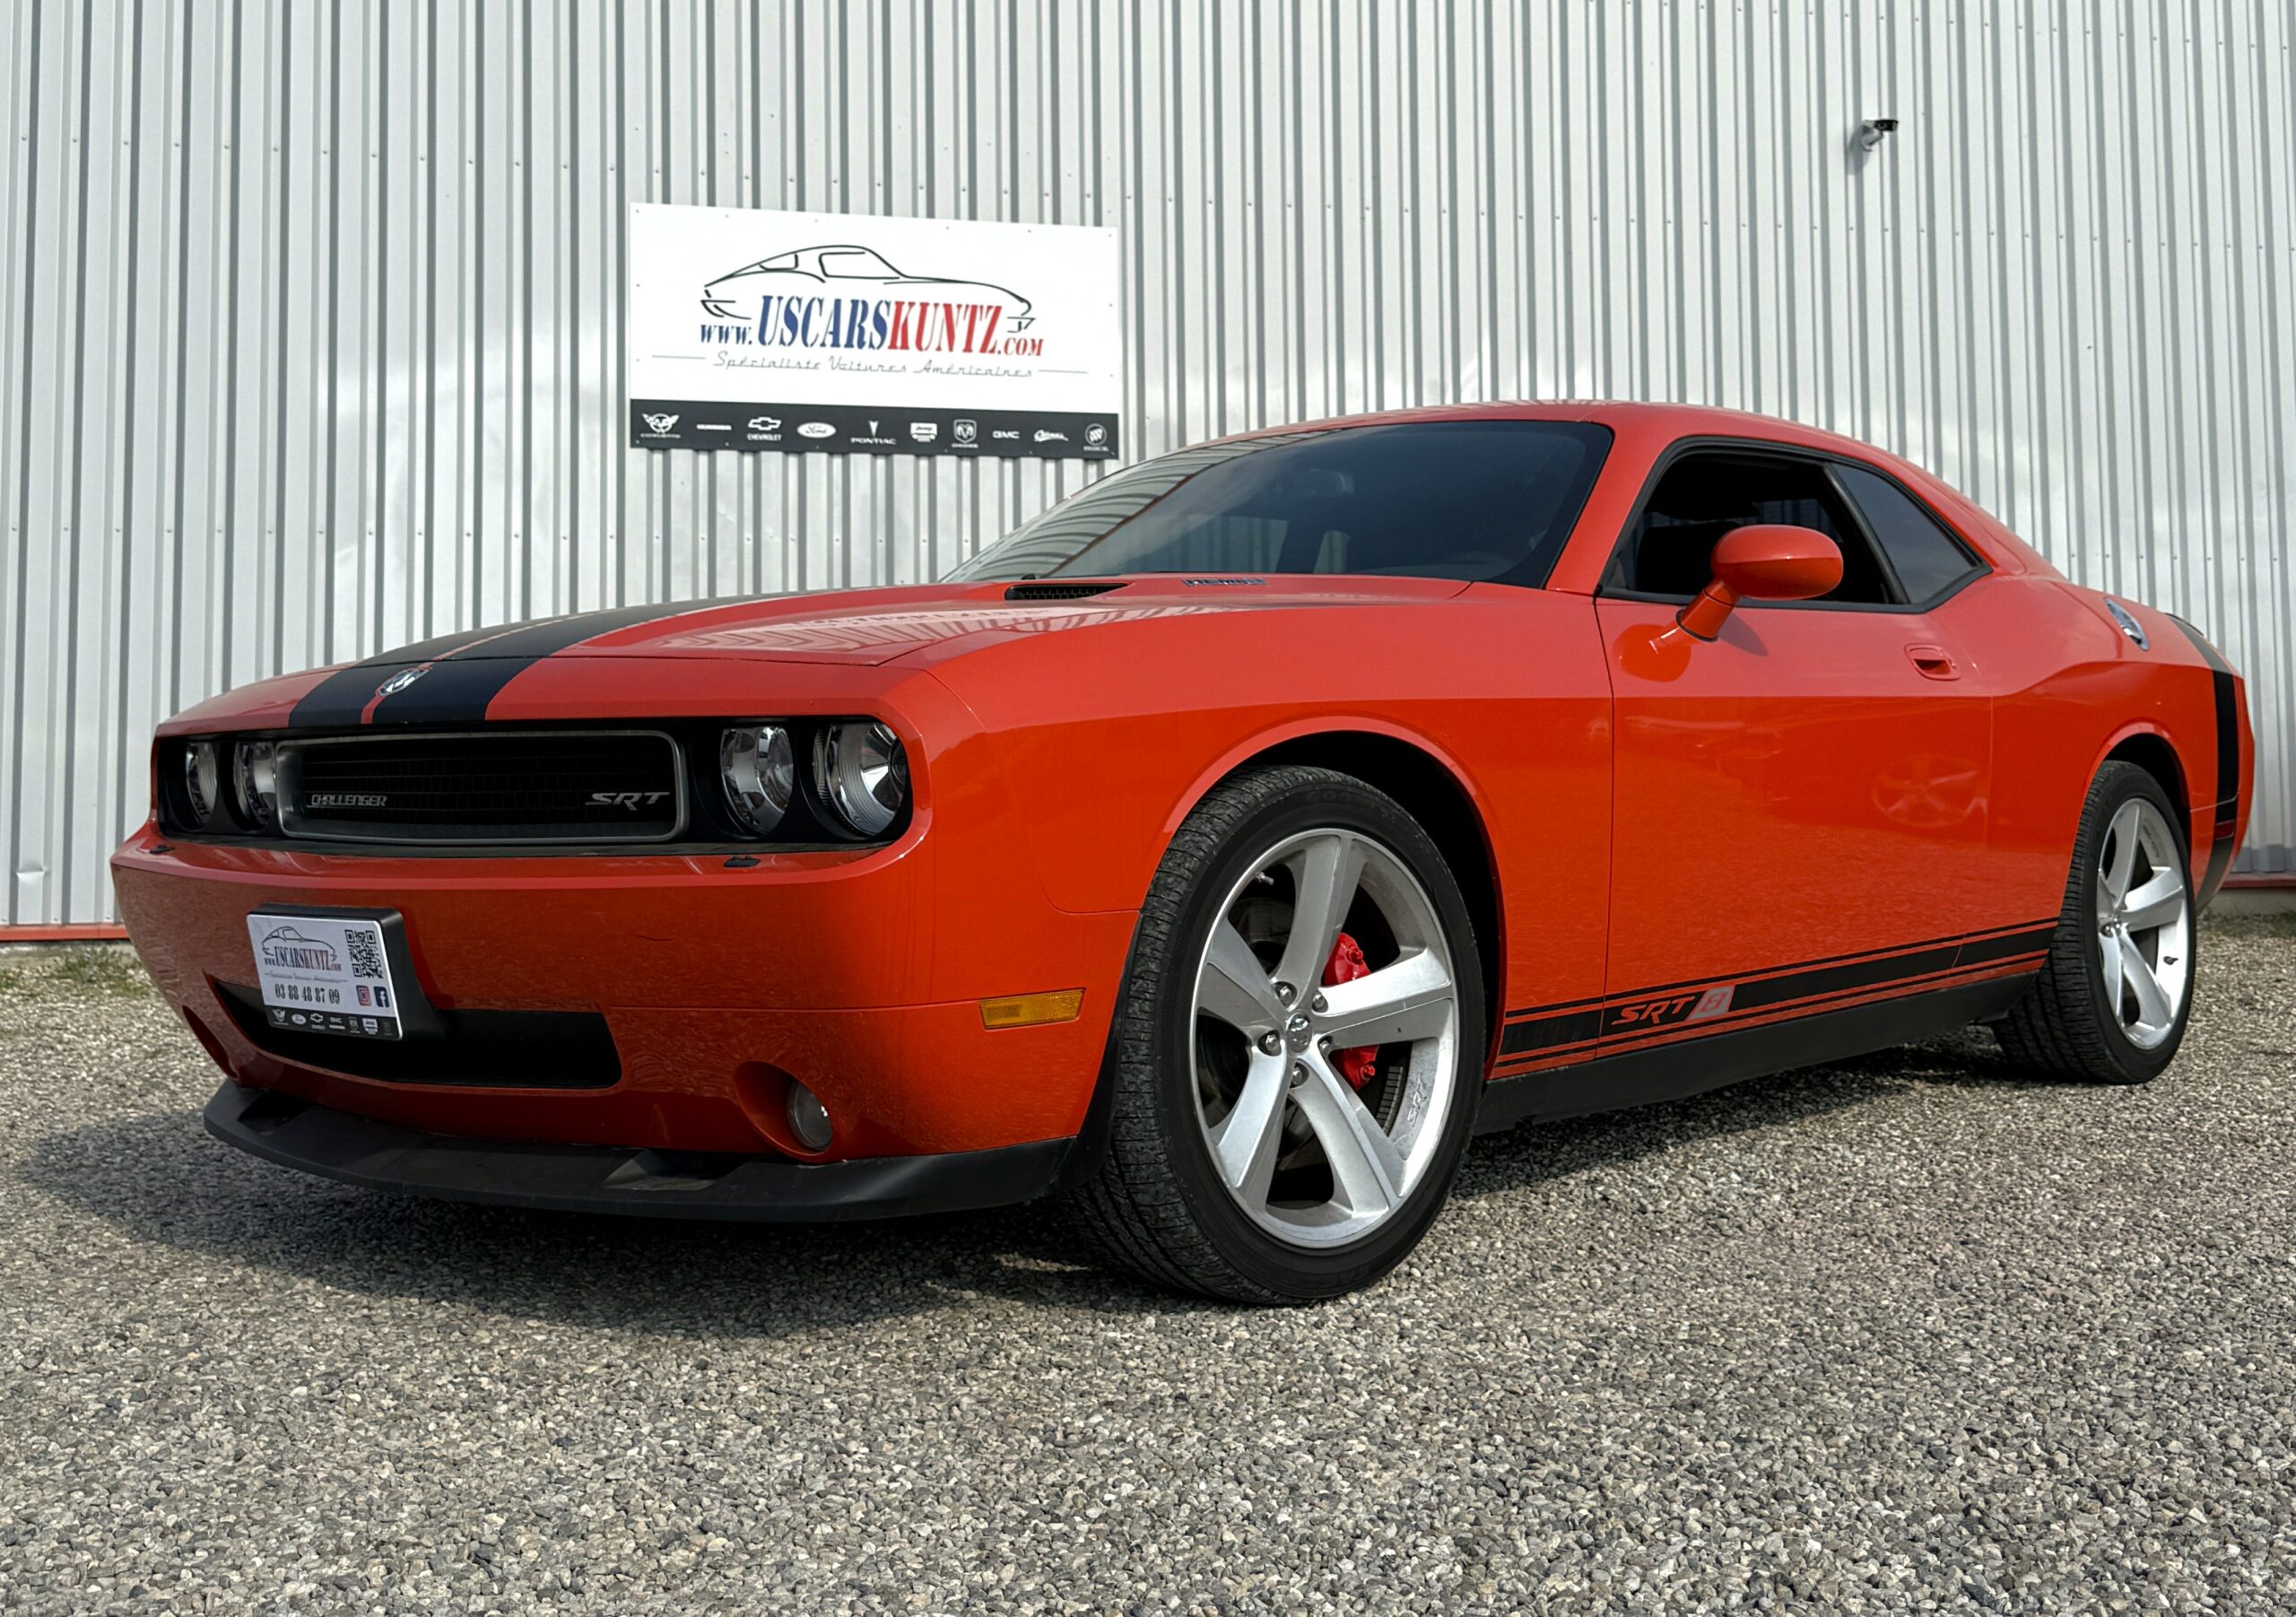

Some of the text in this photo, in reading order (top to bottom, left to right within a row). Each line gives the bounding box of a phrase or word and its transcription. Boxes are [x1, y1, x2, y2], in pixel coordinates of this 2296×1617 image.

[713, 351, 1032, 378] Spécialiste Voitures Américaines
[747, 433, 782, 442] CHEVROLET
[850, 437, 897, 445] PONTIAC
[992, 430, 1020, 439] GMC
[311, 794, 387, 807] CHALLENGER
[585, 792, 670, 811] SRT
[274, 983, 340, 1004] 03 88 48 87 09
[1611, 995, 1695, 1024] SRT
[1406, 1072, 1427, 1127] SRT
